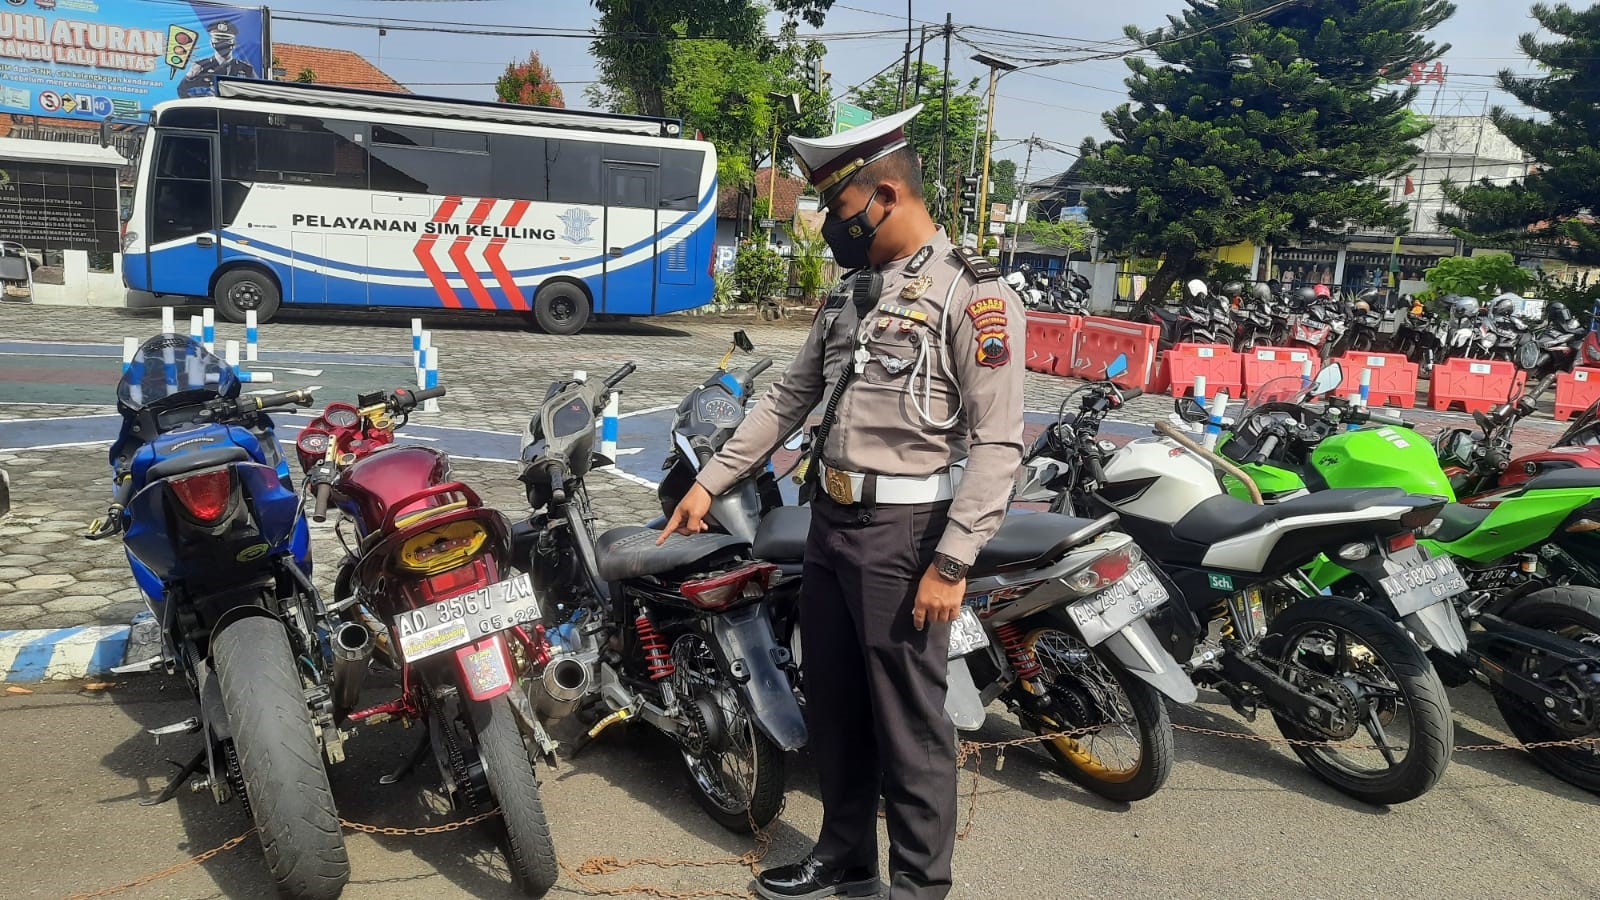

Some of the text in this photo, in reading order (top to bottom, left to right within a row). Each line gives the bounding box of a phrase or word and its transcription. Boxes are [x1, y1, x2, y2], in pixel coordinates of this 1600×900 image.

[0, 13, 164, 55] UHI ATURAN
[55, 45, 97, 65] LALU
[100, 51, 155, 72] LINTAS
[292, 214, 556, 240] PELAYANAN SIM KELILING
[1212, 575, 1233, 590] Sch.
[1382, 575, 1406, 598] AA
[1401, 562, 1437, 590] 5820
[400, 575, 533, 638] AD 3567 ZW
[1073, 602, 1098, 626] AA
[1096, 580, 1131, 611] 2347
